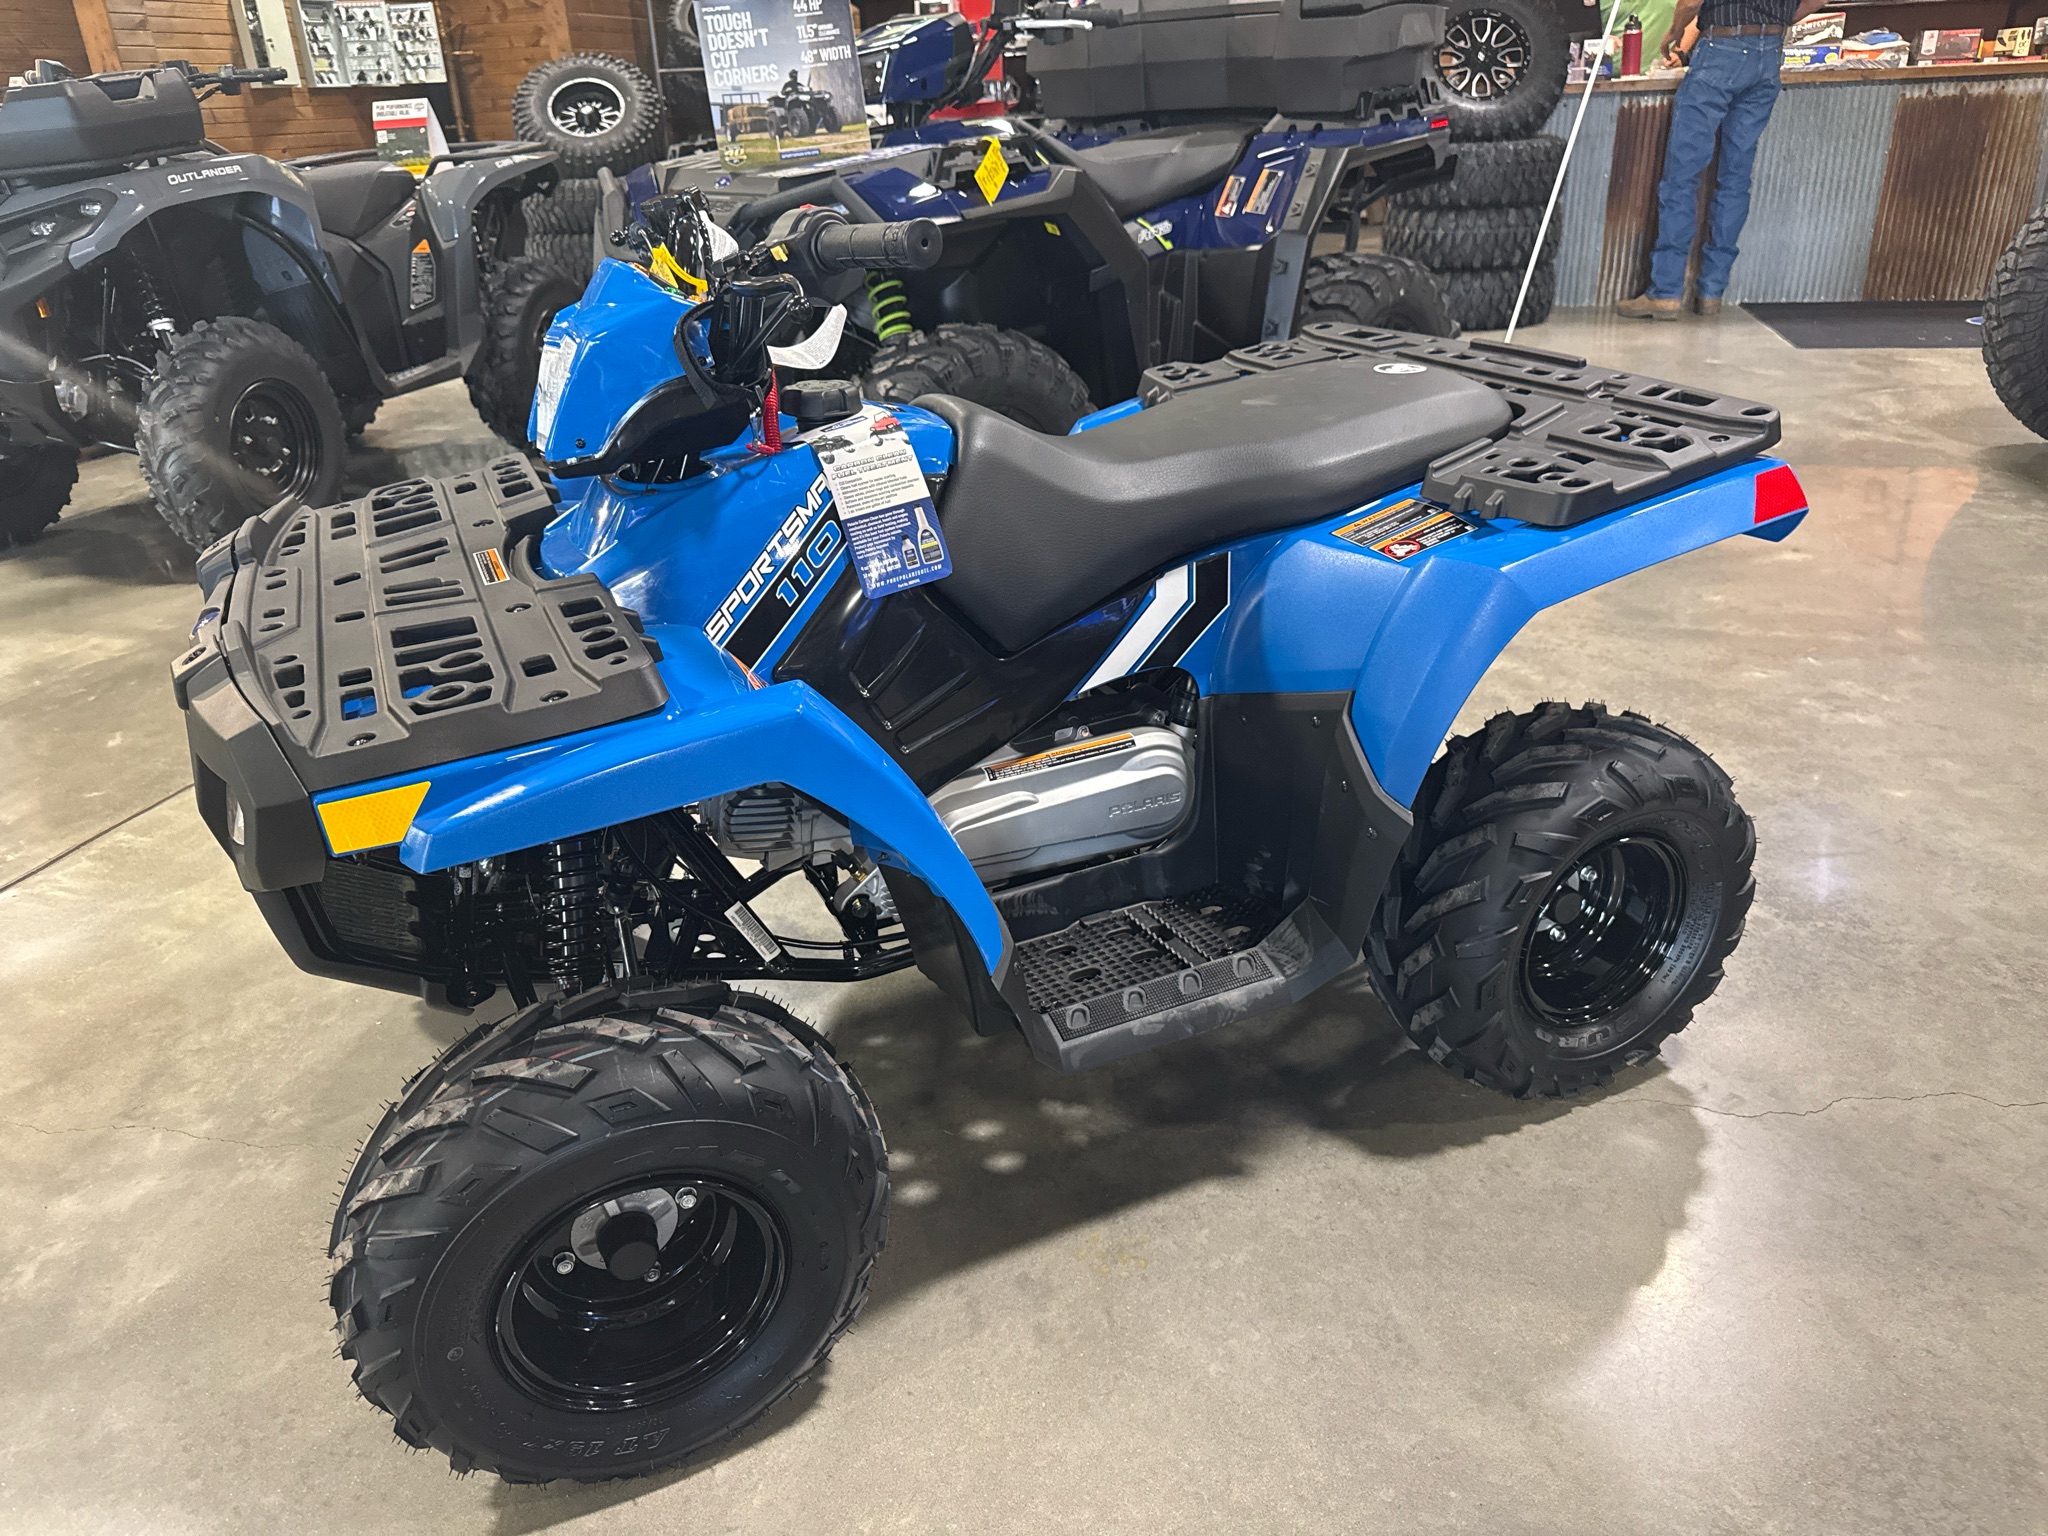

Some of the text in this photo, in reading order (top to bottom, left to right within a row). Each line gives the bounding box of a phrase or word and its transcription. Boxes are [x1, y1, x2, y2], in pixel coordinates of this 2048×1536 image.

[703, 11, 752, 33] TOUGH
[707, 28, 769, 51] DOESN'T
[710, 50, 738, 69] CUT
[819, 44, 852, 62] WIDTH
[714, 63, 780, 87] CORNERS
[167, 165, 242, 185] OUTLANDER
[831, 454, 914, 481] FUEL TREATMENT
[833, 448, 908, 472] CARBON CLEAN
[704, 472, 831, 644] SPORTSMA
[776, 520, 842, 607] 110
[1108, 790, 1181, 818] POLARIS
